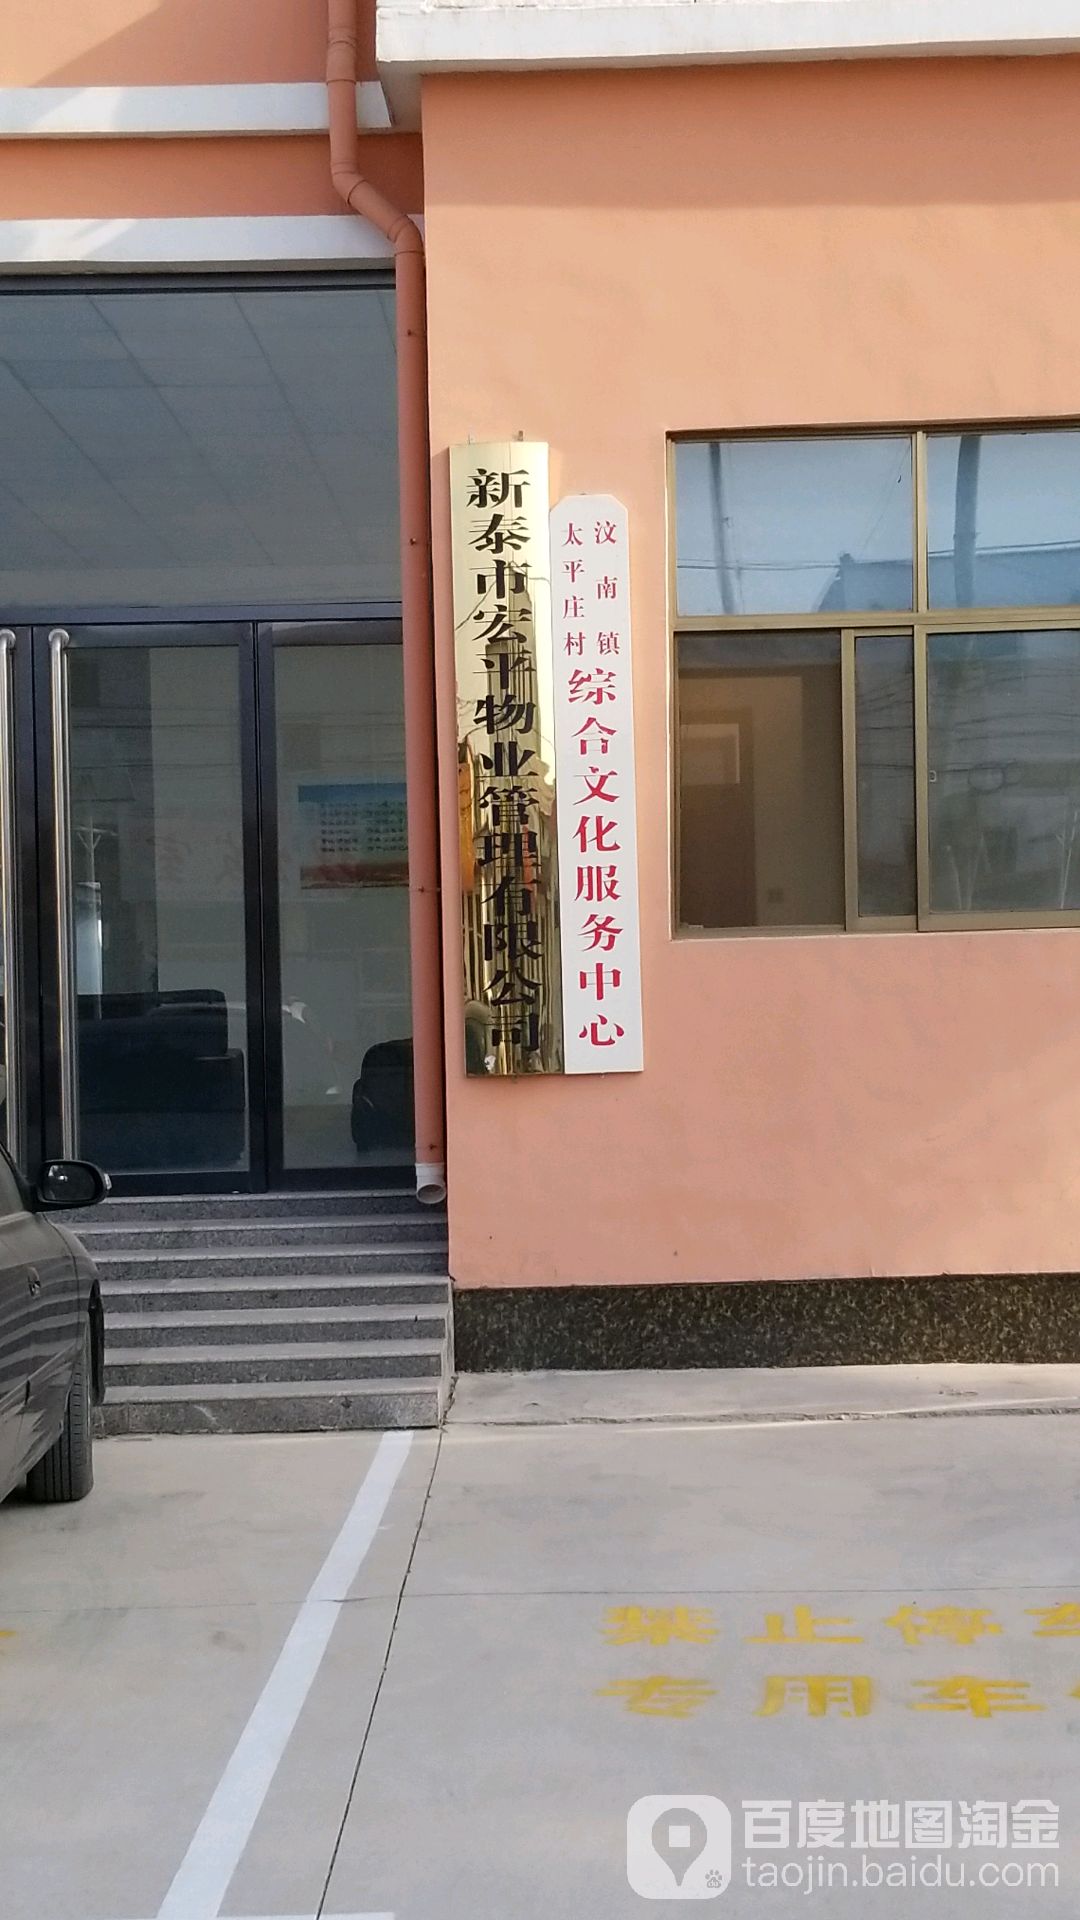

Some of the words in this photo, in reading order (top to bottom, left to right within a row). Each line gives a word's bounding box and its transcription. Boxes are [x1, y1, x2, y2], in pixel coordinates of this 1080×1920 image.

[561, 522, 585, 656] 太平庄村
[594, 520, 621, 656] 汶南镇
[466, 468, 543, 1052] 新泰市宏平物业管理有限公司
[567, 667, 625, 1047] 综合文化服务中心
[594, 1675, 1080, 1718] 专用车
